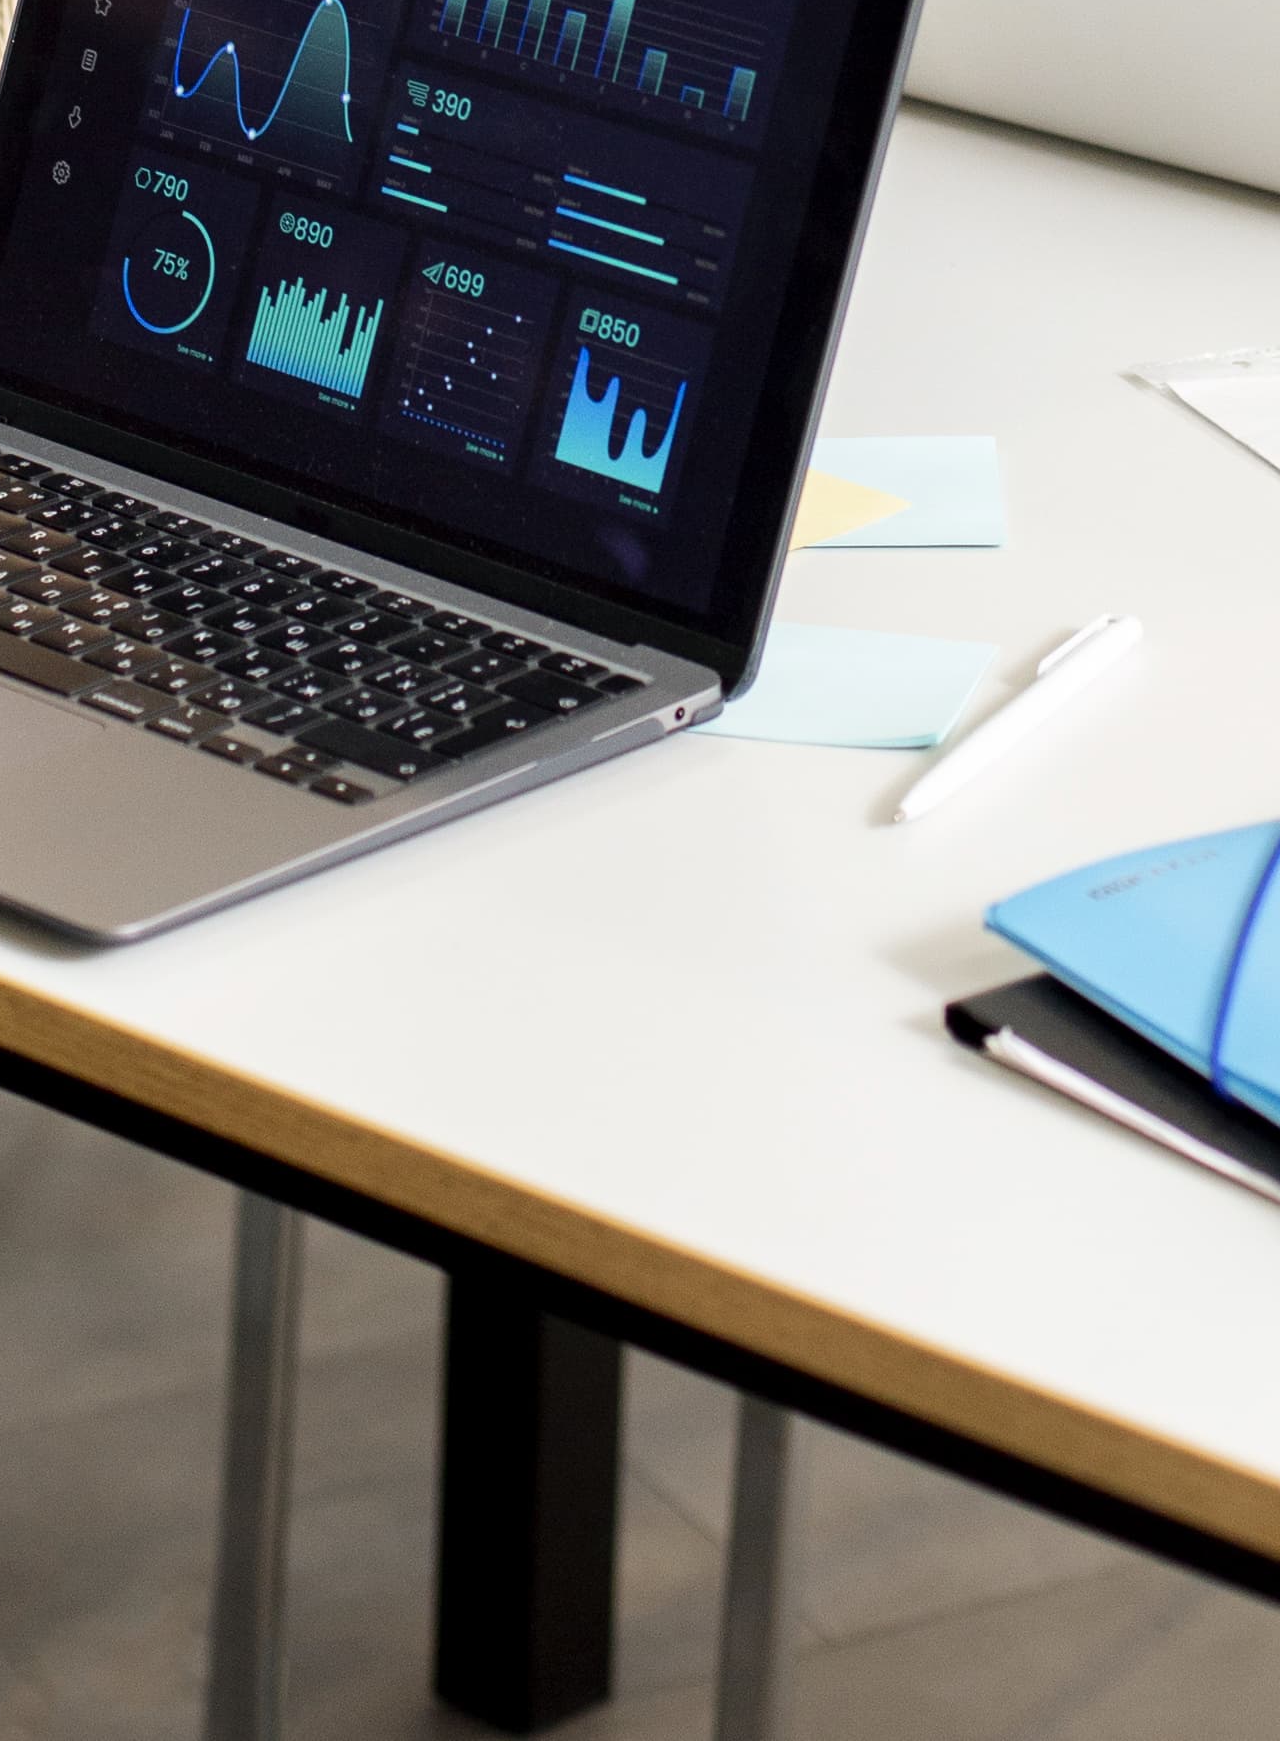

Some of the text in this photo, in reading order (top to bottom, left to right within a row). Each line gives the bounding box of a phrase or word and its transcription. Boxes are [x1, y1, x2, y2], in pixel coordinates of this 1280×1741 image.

[431, 89, 472, 121] 390
[151, 170, 190, 202] 790
[293, 216, 334, 249] 890
[152, 247, 190, 281] 75%
[443, 264, 485, 298] 699
[596, 313, 641, 348] 850
[177, 343, 208, 361] See more
[317, 391, 350, 410] See more
[618, 493, 652, 512] See more
[42, 510, 58, 518] 4
[29, 530, 47, 541] R
[91, 527, 108, 536] 5
[32, 546, 51, 555] К
[82, 549, 99, 559] T
[141, 546, 158, 555] 6
[83, 565, 102, 574] Е
[133, 568, 150, 578] Y
[193, 564, 210, 573] 7
[40, 574, 58, 584] G
[133, 583, 153, 593] Н
[182, 586, 201, 597] U
[243, 583, 261, 593] 8
[41, 589, 61, 599] П
[90, 592, 110, 603] H
[10, 603, 29, 614] B
[186, 602, 204, 611] Г
[295, 602, 313, 611] 9
[93, 608, 112, 617] Р
[141, 613, 159, 621] J
[13, 619, 33, 629] И
[62, 622, 82, 634] N
[232, 619, 256, 631] Ш
[349, 621, 366, 631] 0
[145, 627, 164, 637] О
[287, 625, 306, 635] O
[193, 631, 212, 642] K
[67, 639, 84, 648] Т
[113, 642, 135, 654] M
[285, 639, 309, 652] Щ
[338, 643, 358, 653] P
[195, 647, 217, 658] Л
[245, 650, 260, 661] L
